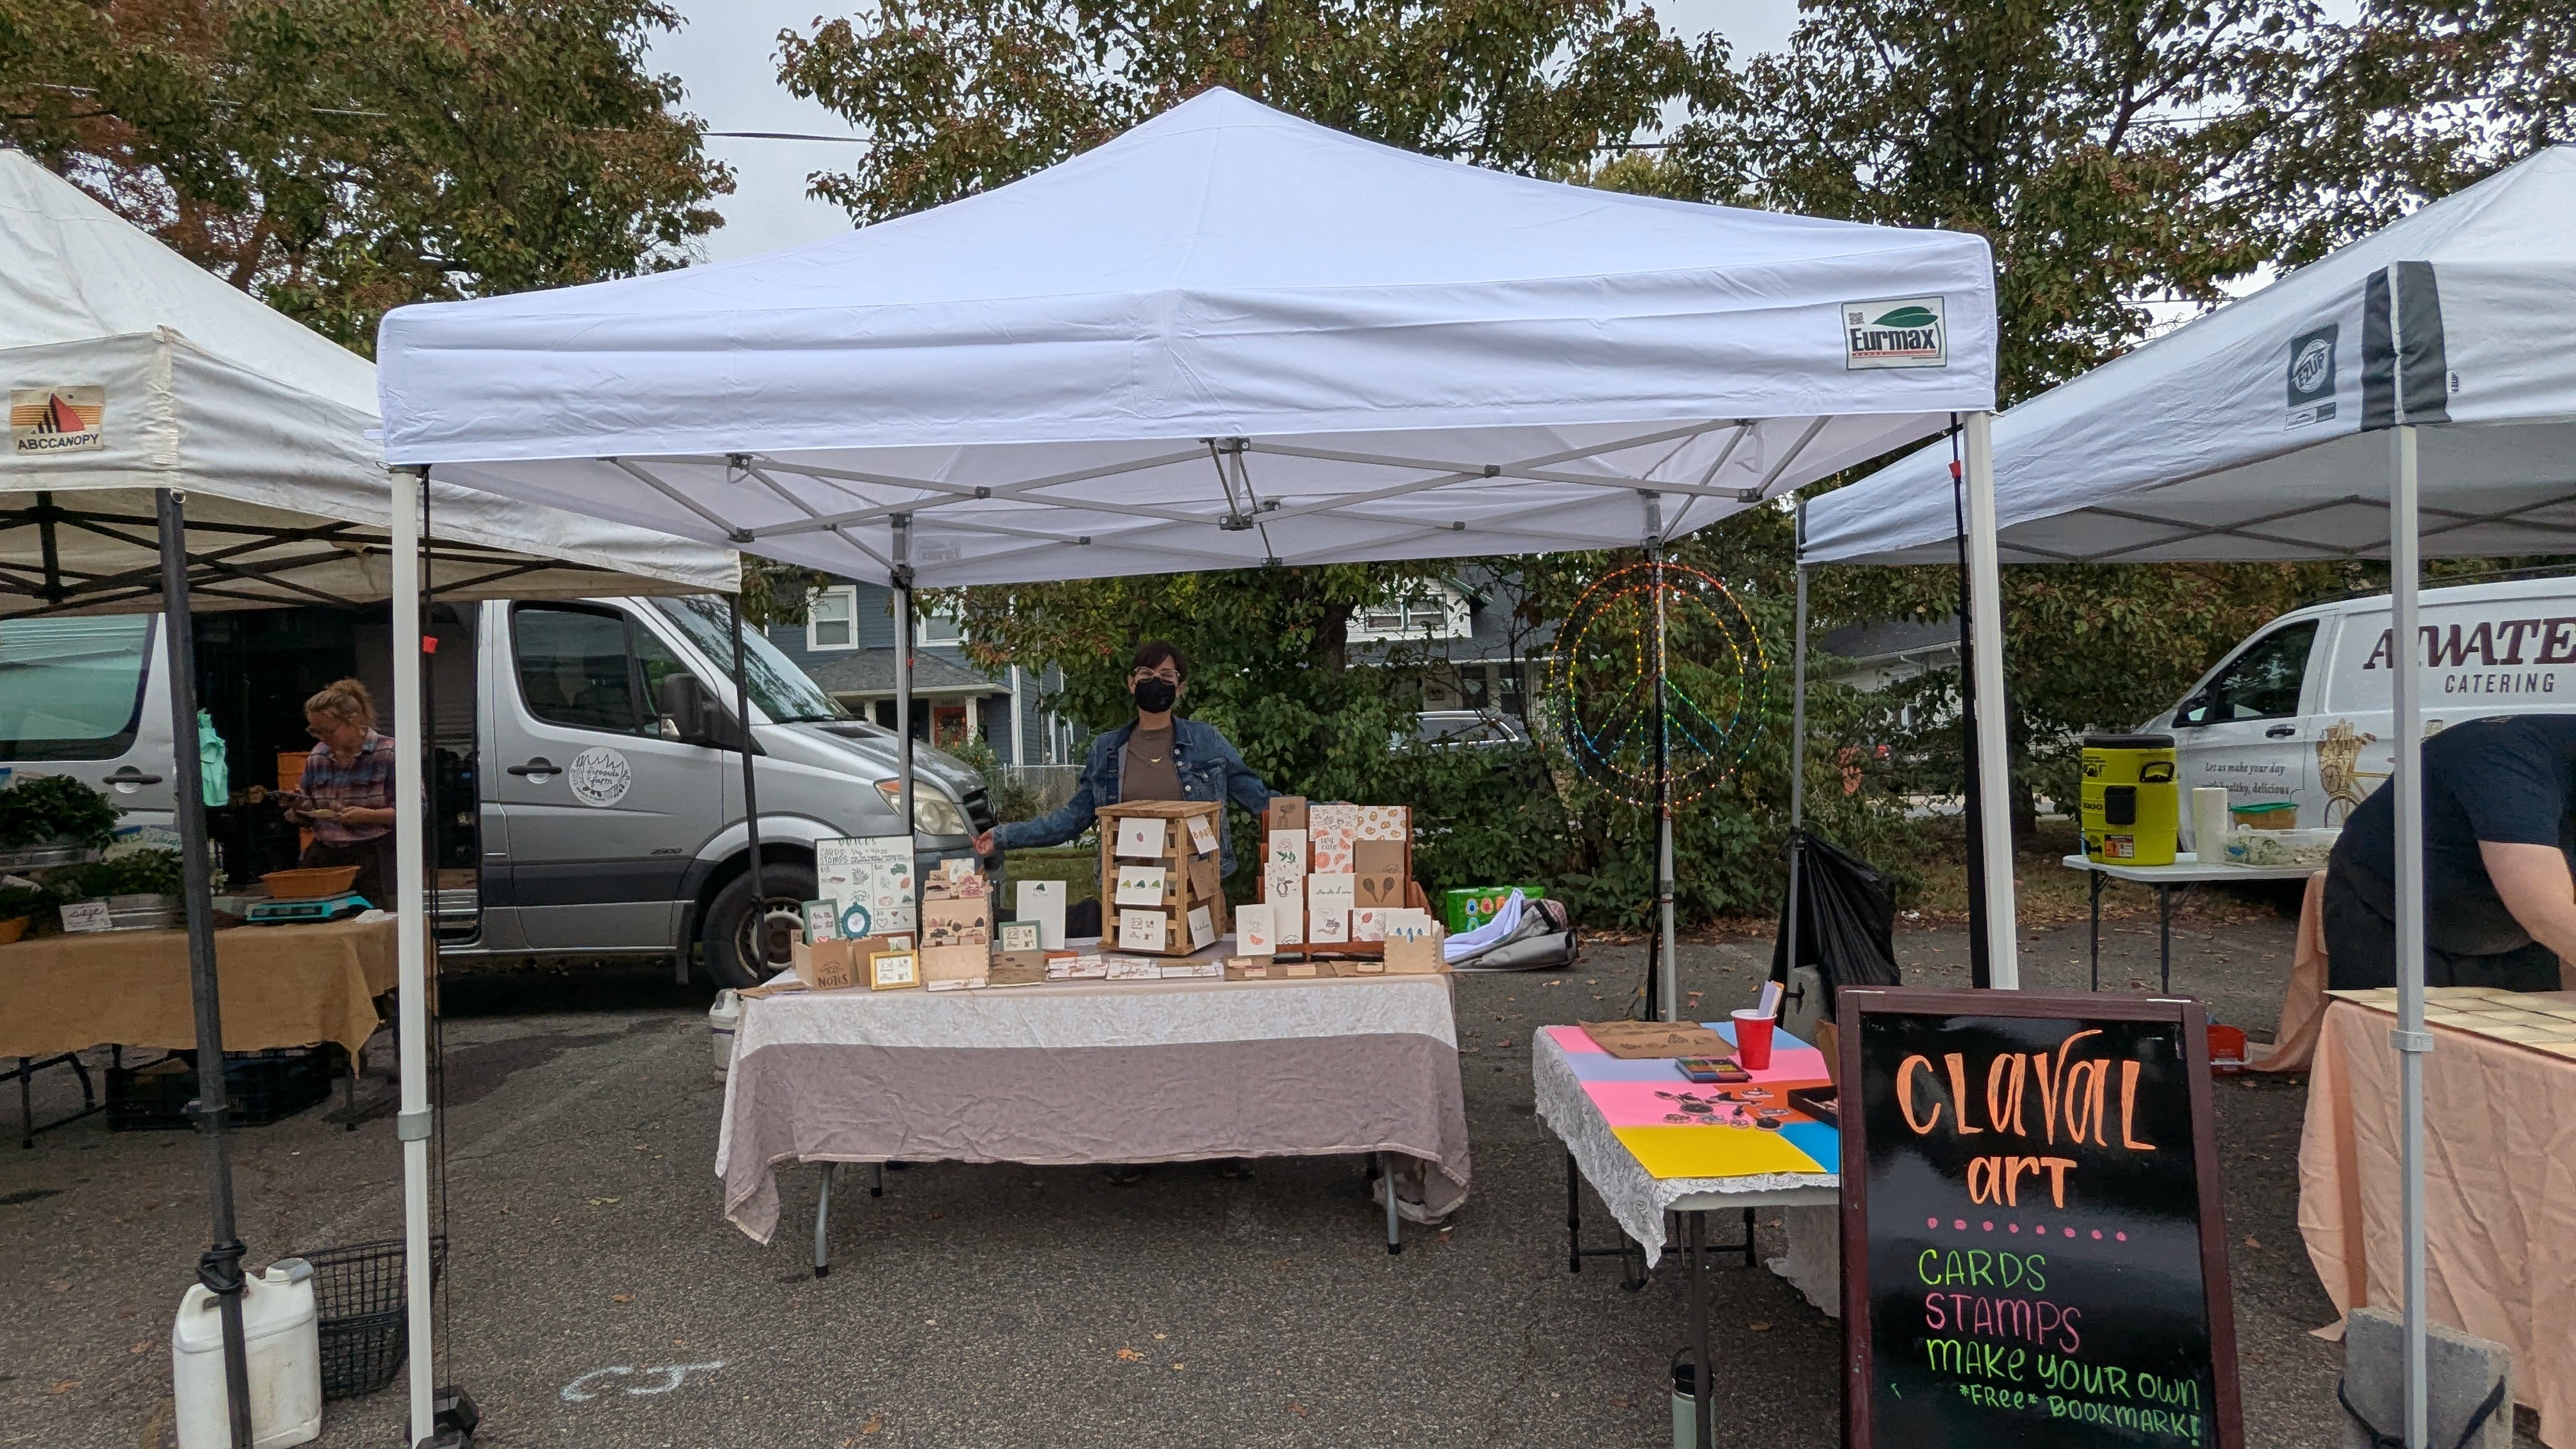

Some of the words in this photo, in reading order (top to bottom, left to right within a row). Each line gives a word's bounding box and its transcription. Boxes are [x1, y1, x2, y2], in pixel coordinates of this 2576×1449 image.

[1850, 328, 1936, 351] Eurmax
[18, 433, 99, 450] ABCCANOPY
[2445, 673, 2555, 693] CATERING
[2205, 762, 2215, 771] Let
[2227, 762, 2248, 772] make
[2248, 765, 2269, 775] your
[2269, 762, 2286, 776] day
[590, 775, 613, 788] farm
[2253, 783, 2290, 794] delicious
[817, 973, 848, 988] NOTES
[1919, 1249, 2046, 1291] CARDS
